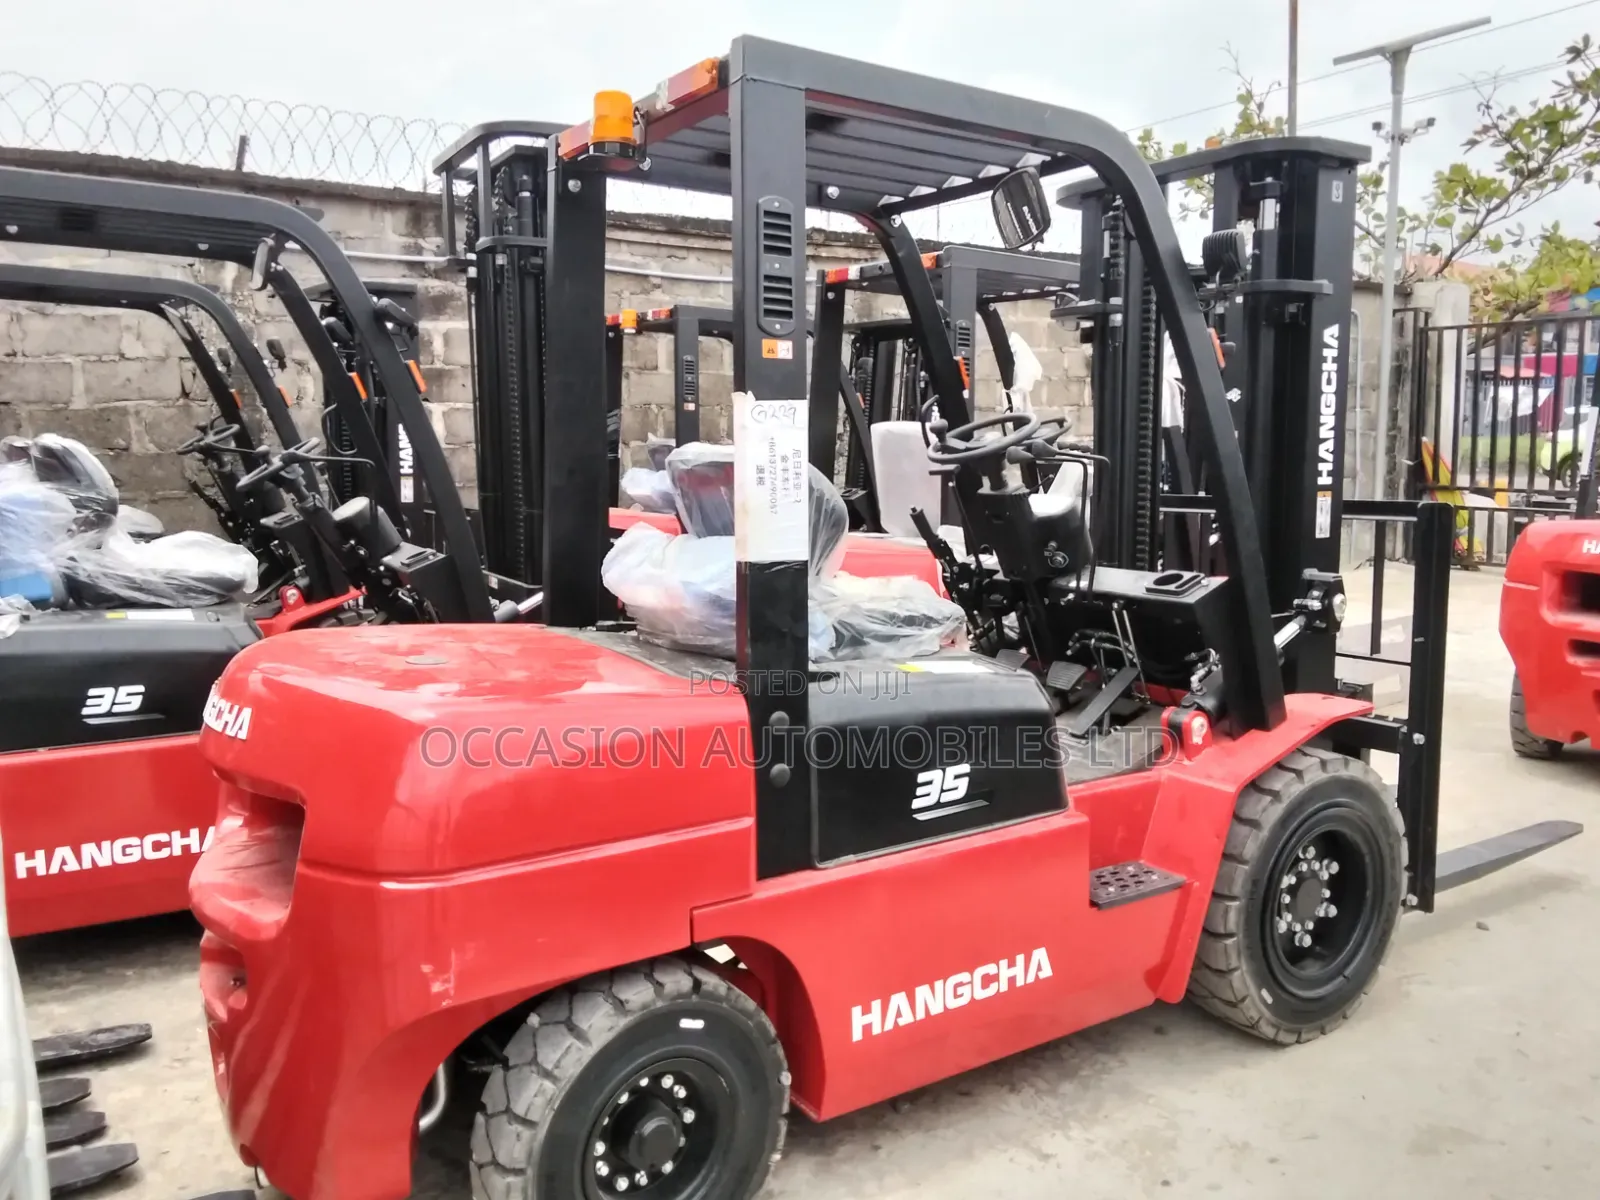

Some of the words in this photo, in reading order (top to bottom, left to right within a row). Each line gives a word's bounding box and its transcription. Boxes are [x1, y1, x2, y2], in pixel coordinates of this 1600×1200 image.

[1316, 323, 1339, 486] HANGCHA
[80, 684, 146, 715] 35
[911, 763, 971, 809] 35
[851, 946, 1054, 1042] HANGCHA
